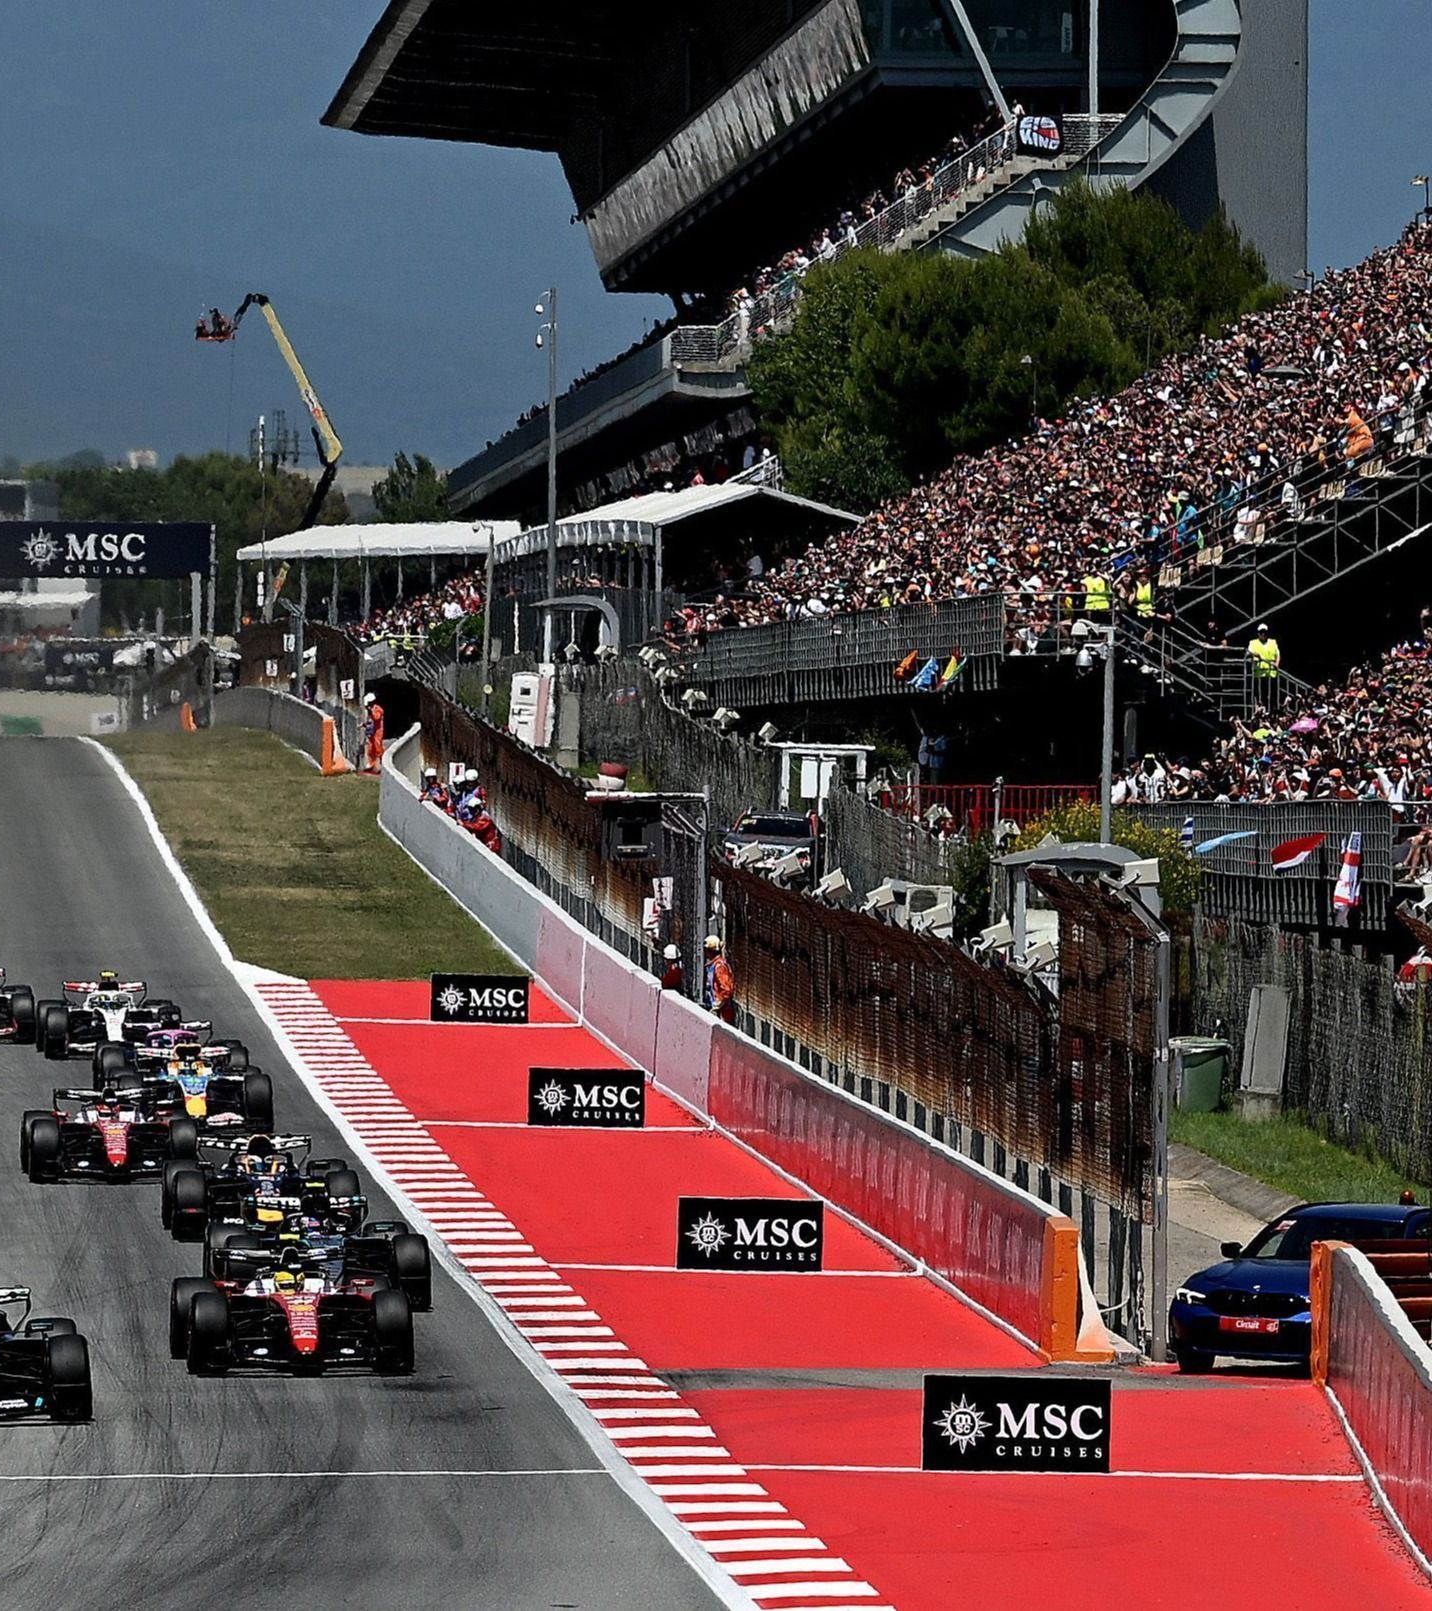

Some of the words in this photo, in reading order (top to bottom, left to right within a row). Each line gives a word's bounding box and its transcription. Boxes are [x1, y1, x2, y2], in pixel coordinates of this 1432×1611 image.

[65, 533, 146, 562] MSC
[469, 988, 525, 1008] MSC
[572, 1084, 641, 1108] MSC
[733, 1217, 818, 1248] MSC
[733, 1250, 817, 1262] CRUISES
[995, 1403, 1104, 1441] MSC
[995, 1445, 1104, 1460] CRUISES
